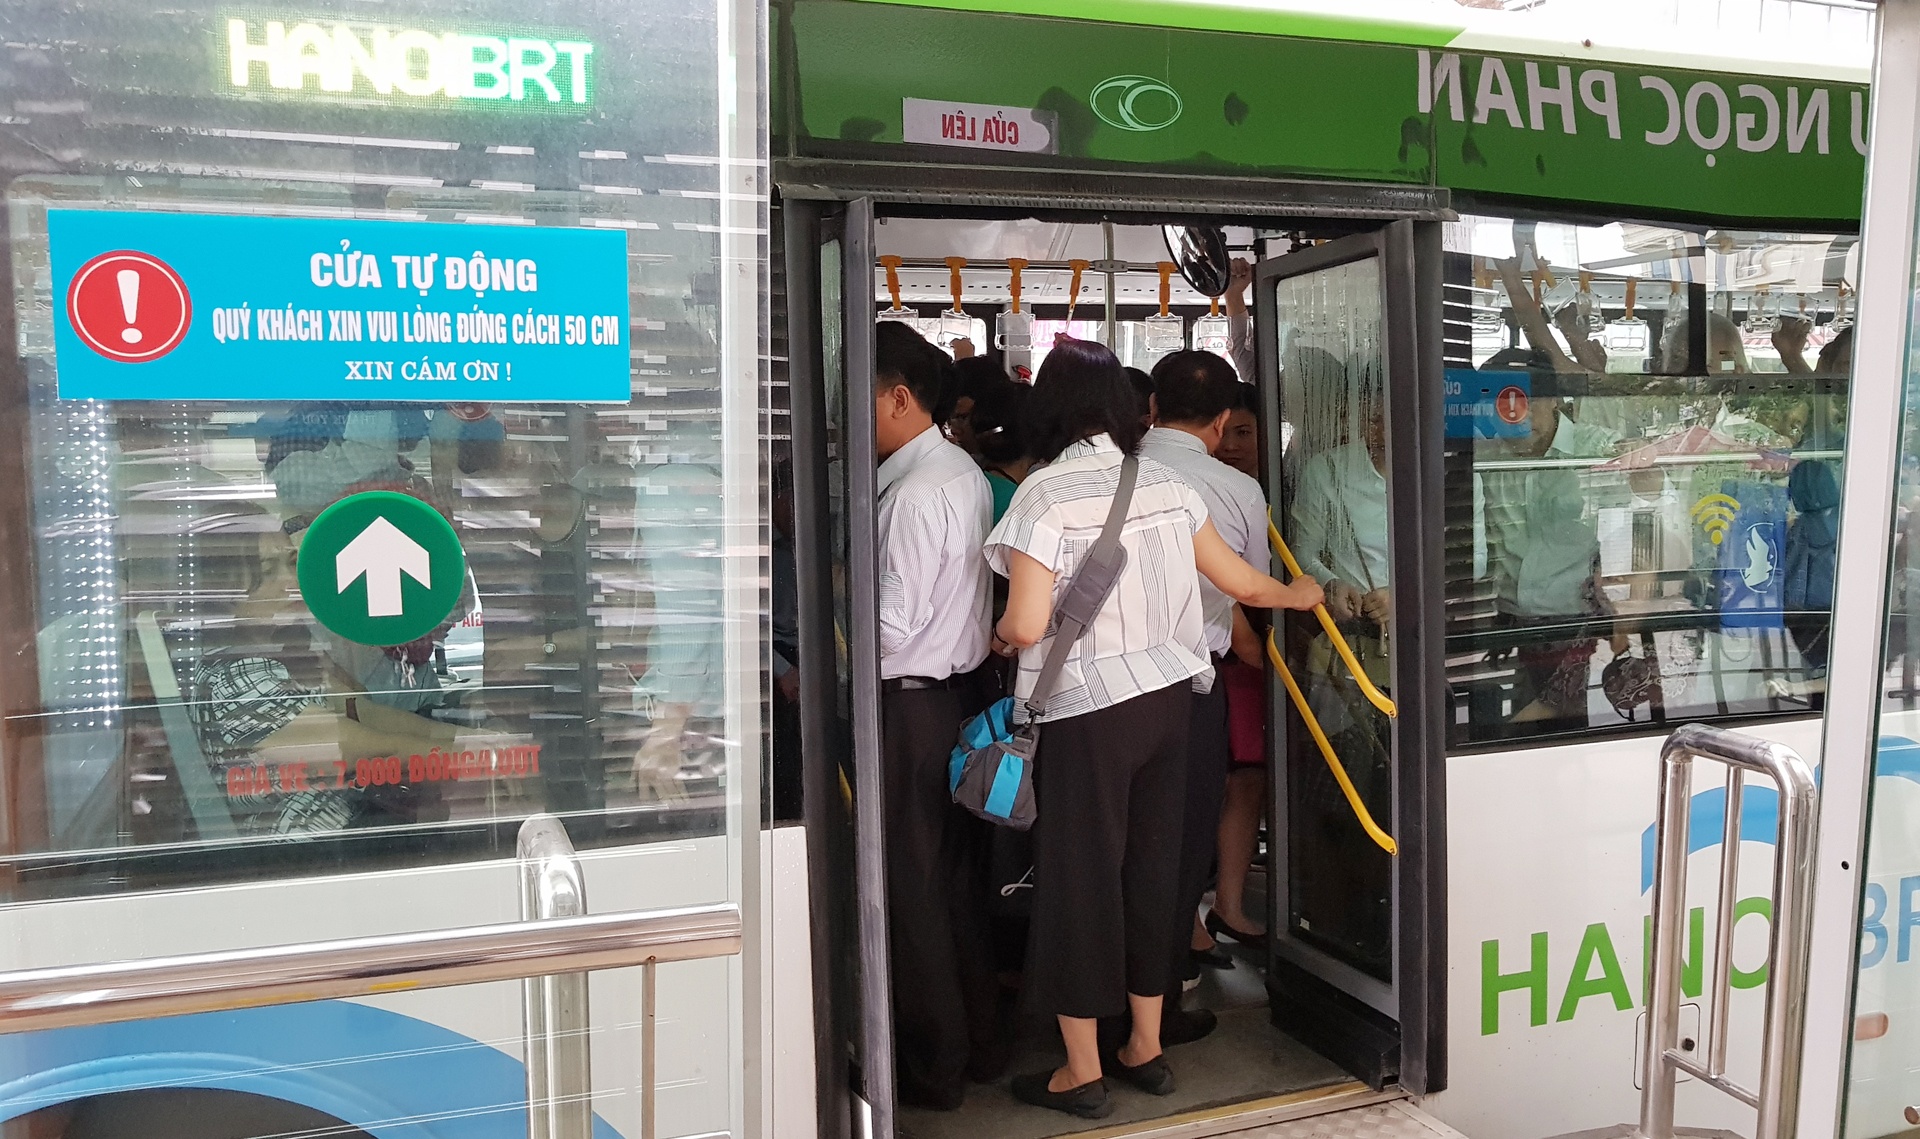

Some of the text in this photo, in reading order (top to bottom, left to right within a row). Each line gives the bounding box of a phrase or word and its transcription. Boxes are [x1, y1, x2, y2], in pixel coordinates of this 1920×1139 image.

[310, 239, 538, 298] CỬA TỰ ĐỘNG
[212, 302, 619, 346] QUÝ KHÁCH XIN VUI LÒNG ĐỨNG CÁCH 50 CM
[345, 360, 394, 381] XIN
[401, 356, 457, 381] CÁM
[462, 360, 500, 381] ƠN
[332, 756, 402, 789] 7.000
